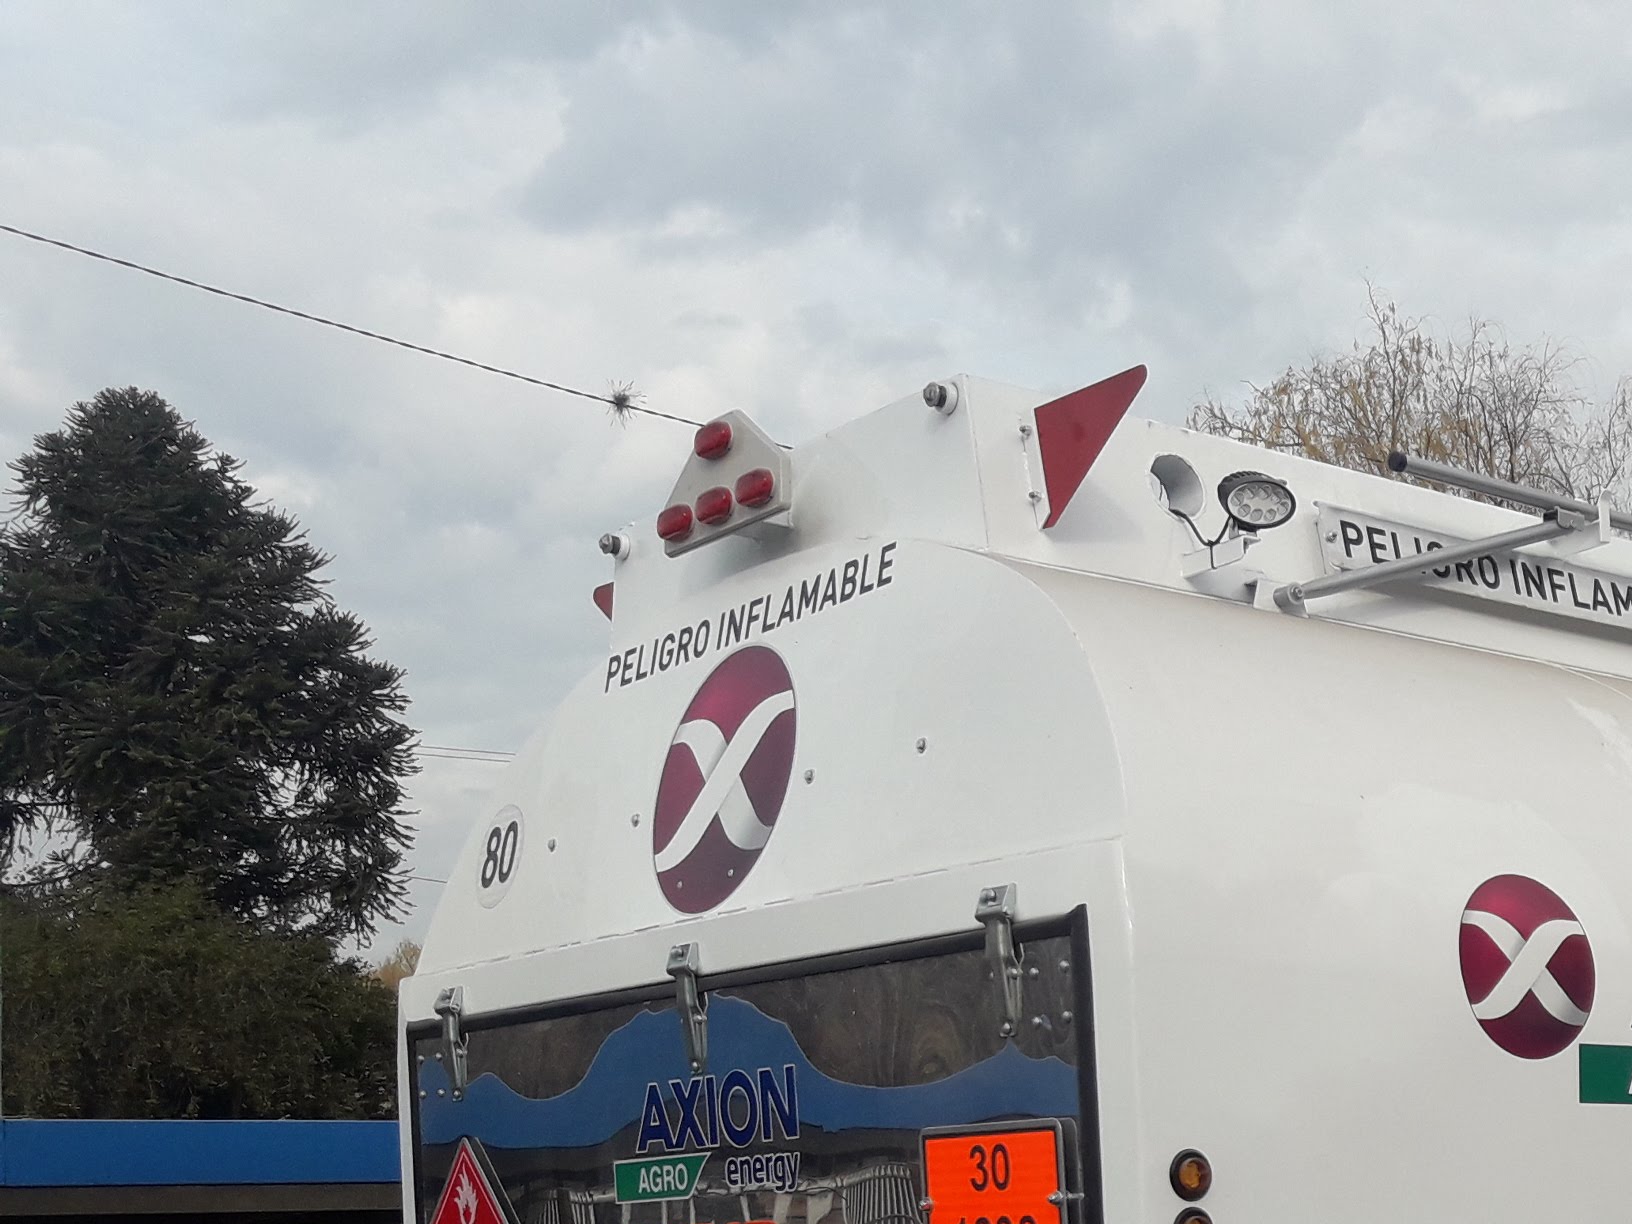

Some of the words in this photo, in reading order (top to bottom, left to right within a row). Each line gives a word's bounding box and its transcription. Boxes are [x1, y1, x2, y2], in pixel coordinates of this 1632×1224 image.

[605, 619, 710, 693] PELIGRO
[716, 541, 897, 650] INFLAMABLE
[481, 820, 518, 889] 80
[636, 1064, 800, 1153] AXION
[639, 1162, 689, 1194] AGRO
[725, 1152, 800, 1193] energy
[969, 1143, 1010, 1192] 30
